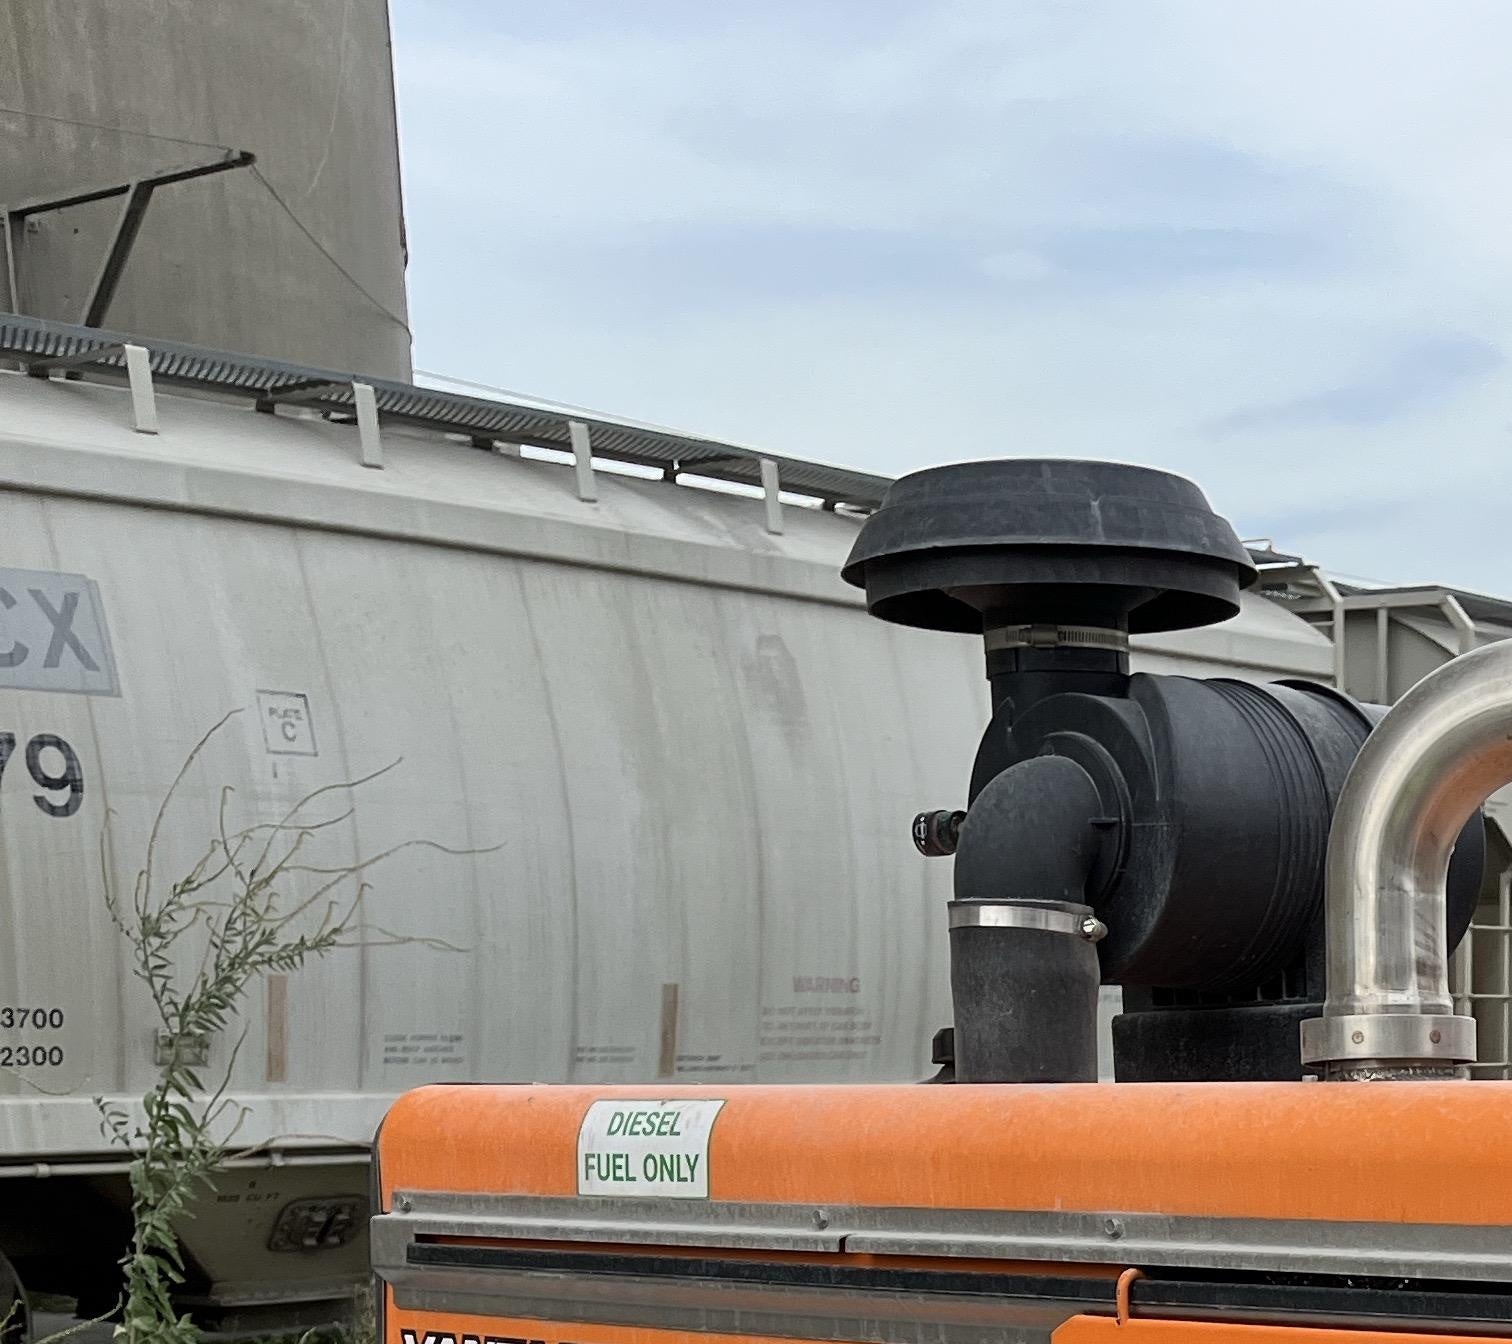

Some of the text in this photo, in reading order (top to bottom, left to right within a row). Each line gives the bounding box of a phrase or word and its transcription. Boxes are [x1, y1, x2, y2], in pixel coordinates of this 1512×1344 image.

[606, 1111, 682, 1137] DIESEL
[584, 1153, 700, 1183] FUEL ONLY
